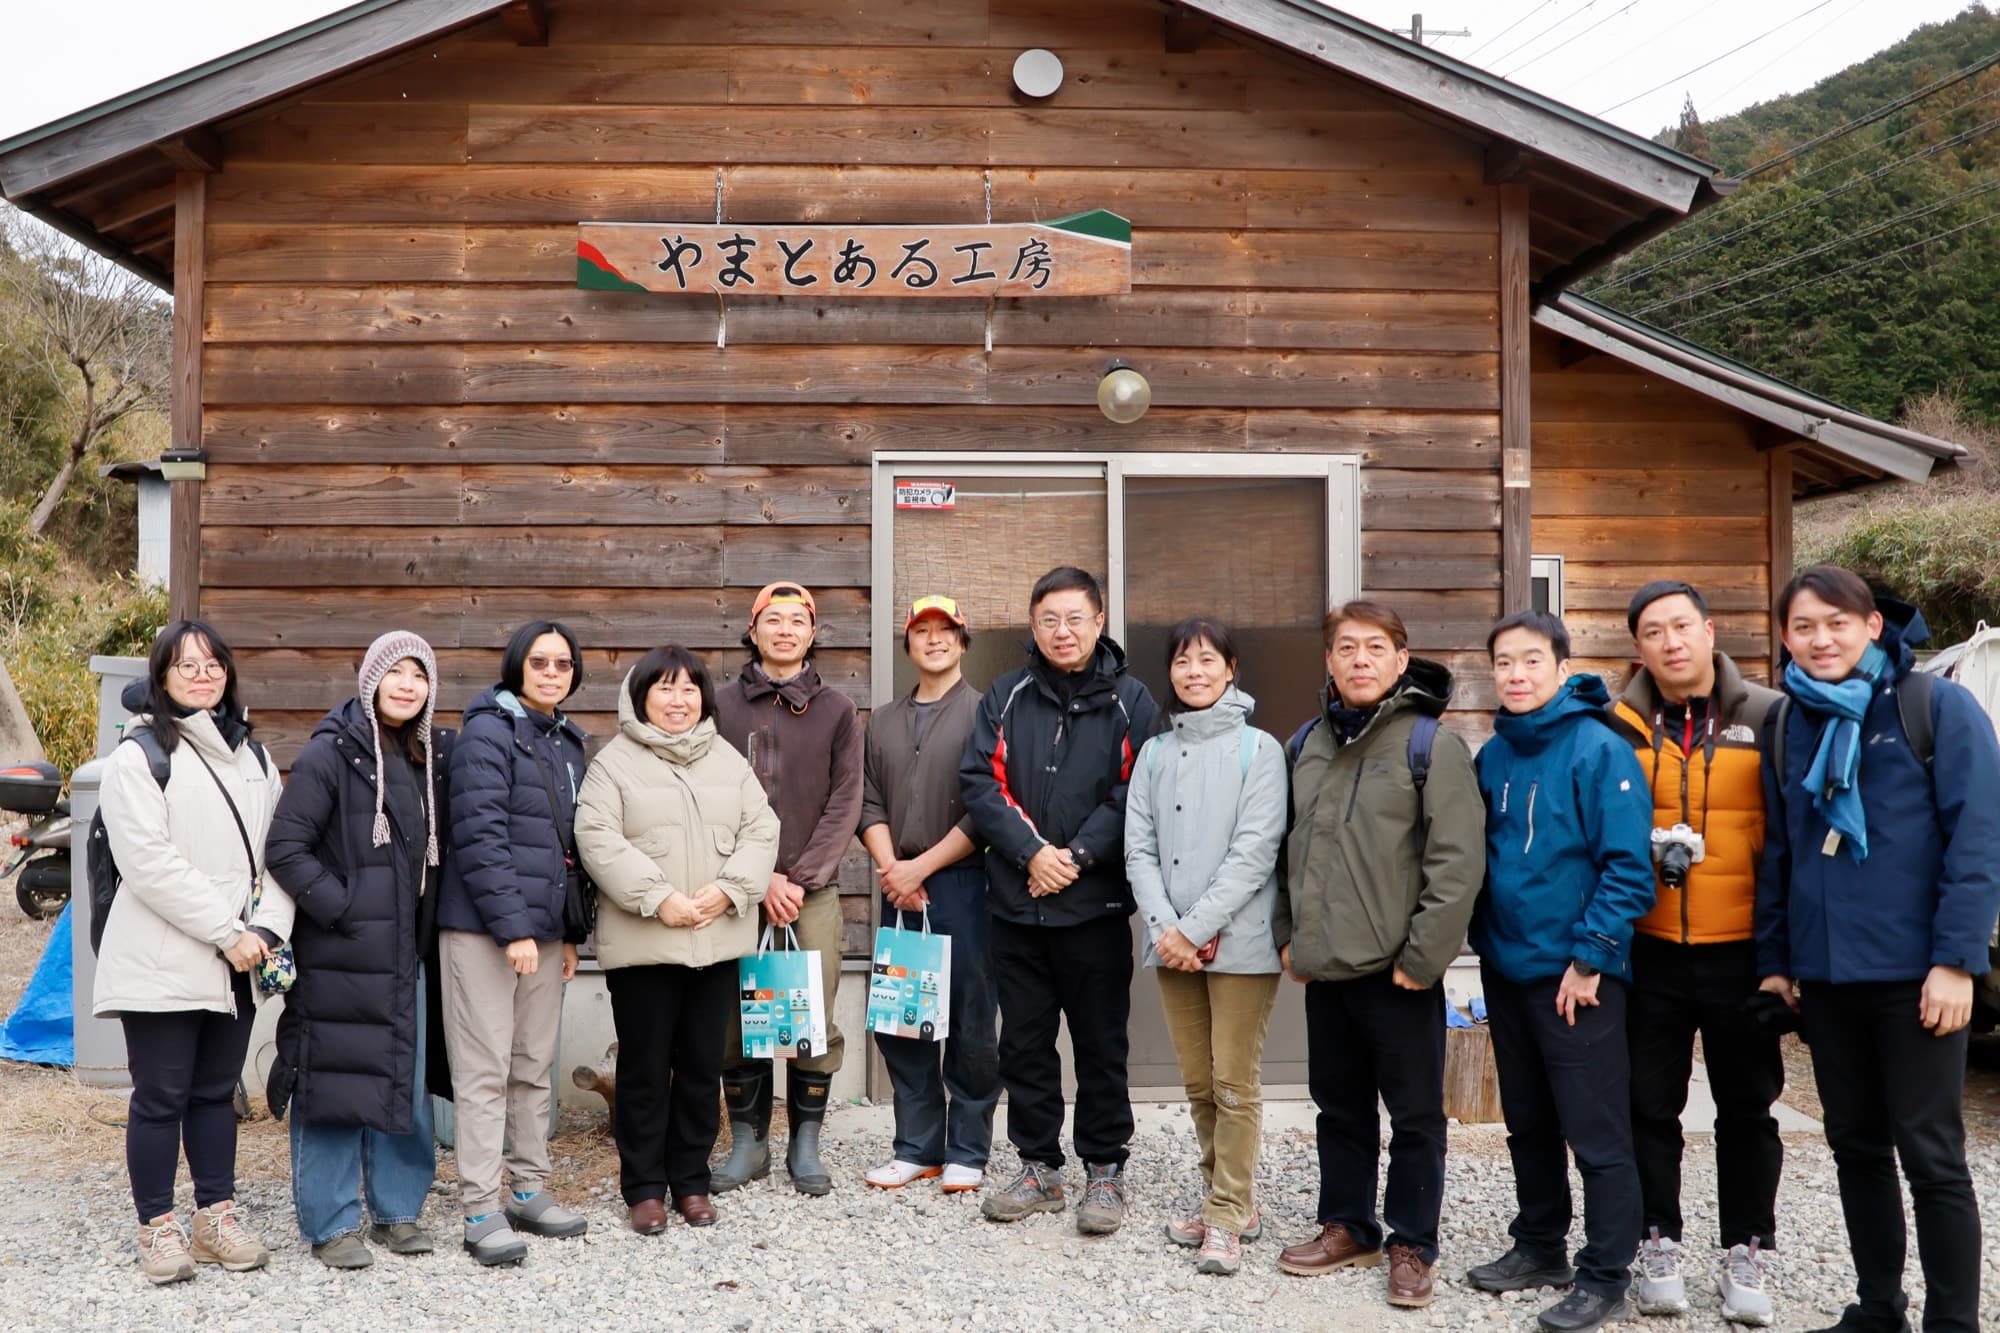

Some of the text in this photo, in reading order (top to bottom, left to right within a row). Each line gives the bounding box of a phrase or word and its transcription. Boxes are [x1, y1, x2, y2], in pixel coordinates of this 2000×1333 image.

[658, 233, 1052, 289] やまとある工房
[899, 488, 931, 496] 防犯カメラ
